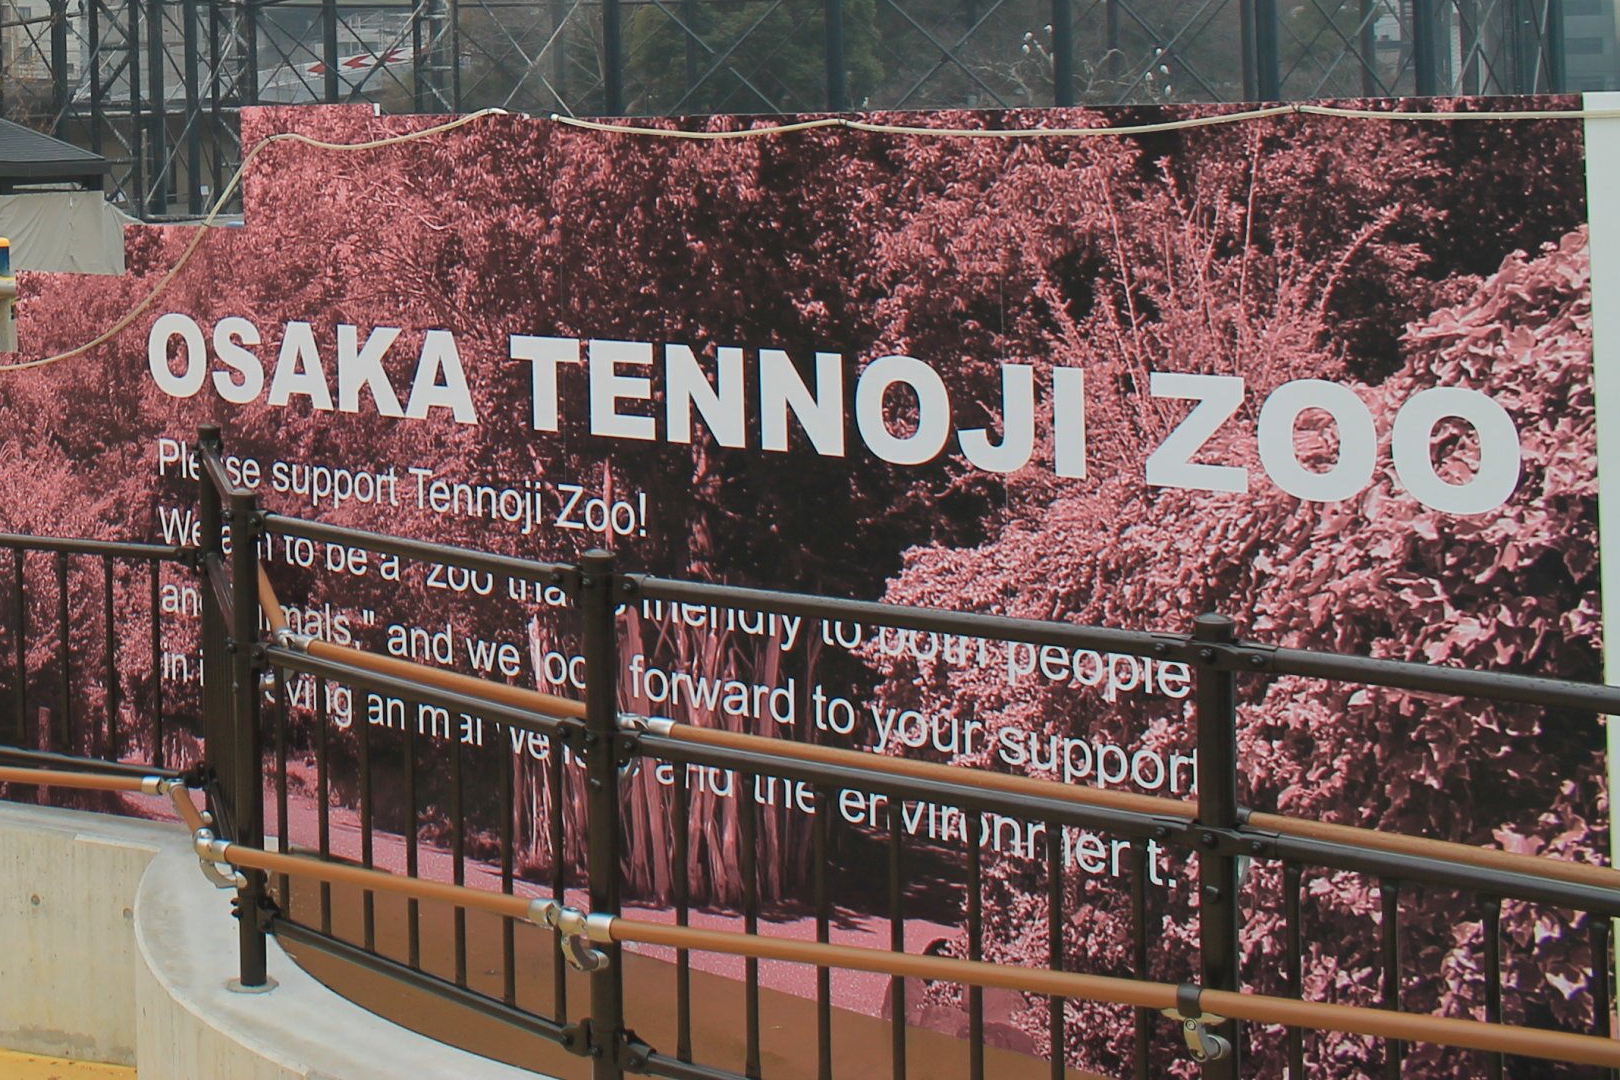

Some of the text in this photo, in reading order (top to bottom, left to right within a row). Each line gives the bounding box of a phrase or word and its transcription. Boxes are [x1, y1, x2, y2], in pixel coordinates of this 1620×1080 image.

[148, 313, 1521, 514] OSAKA TENNOJI ZOO
[158, 438, 647, 537] Plese support Tennoji Zoo!
[162, 583, 203, 617] an
[387, 624, 453, 665] and
[466, 637, 521, 677] we
[533, 632, 586, 689] loo
[628, 654, 795, 725] forward
[812, 684, 855, 735] to
[871, 705, 983, 754] your
[284, 533, 314, 567] to
[326, 541, 368, 575] be
[380, 553, 400, 581] a
[1009, 641, 1192, 703] people
